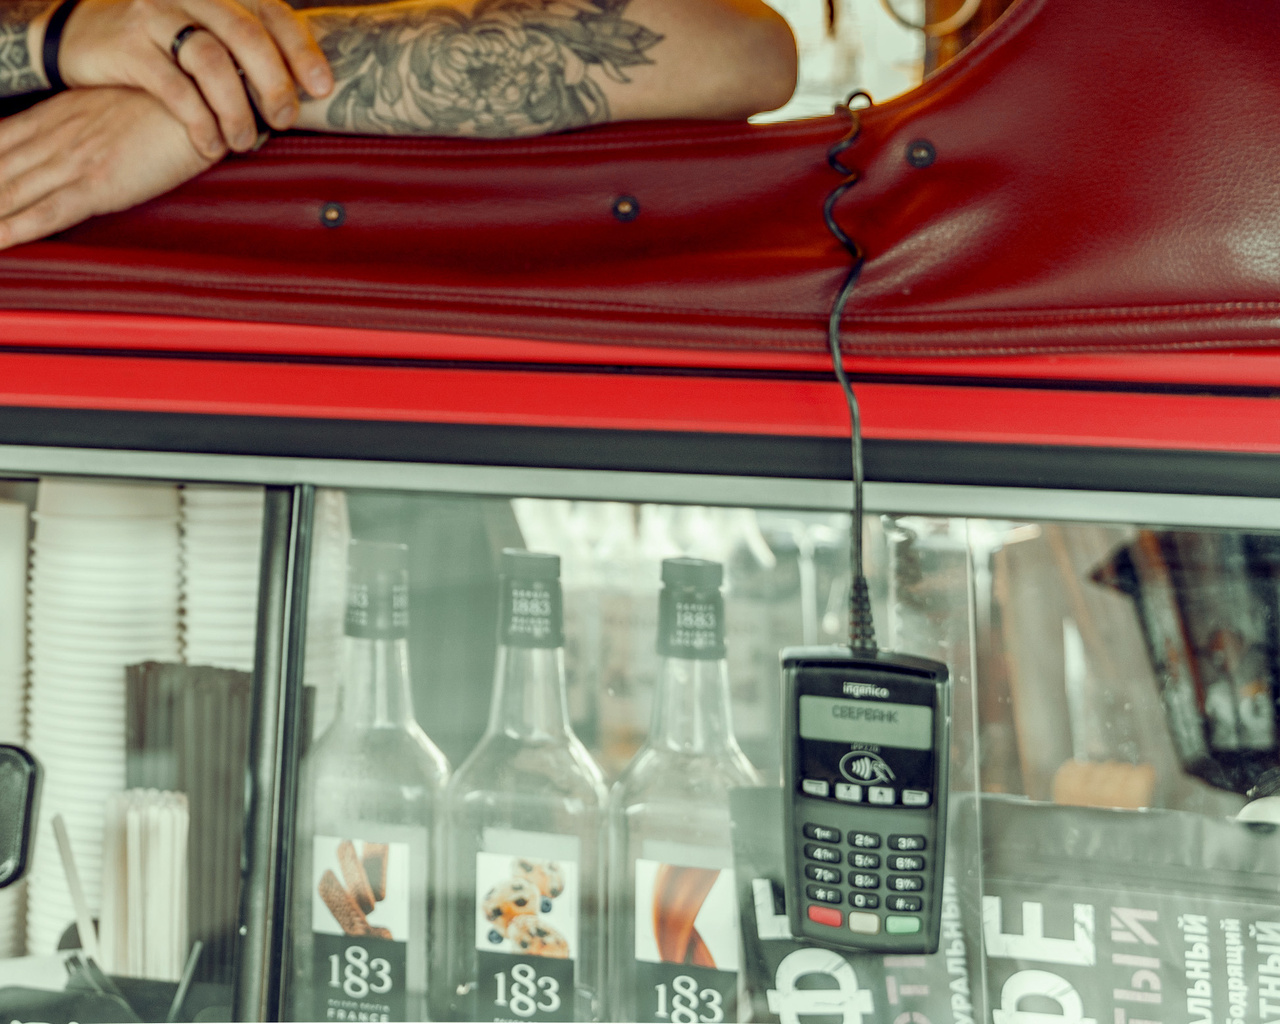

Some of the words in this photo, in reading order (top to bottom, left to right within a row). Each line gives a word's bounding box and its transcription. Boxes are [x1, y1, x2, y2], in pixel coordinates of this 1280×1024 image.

[843, 681, 890, 698] ingenico
[328, 945, 393, 998] 1883
[494, 963, 561, 1018] 1883
[1178, 914, 1212, 1023] ЛЬНЫЙ
[1249, 921, 1280, 1023] ТНЫЙ
[327, 1007, 389, 1022] FRANCE
[655, 975, 724, 1023] 1883
